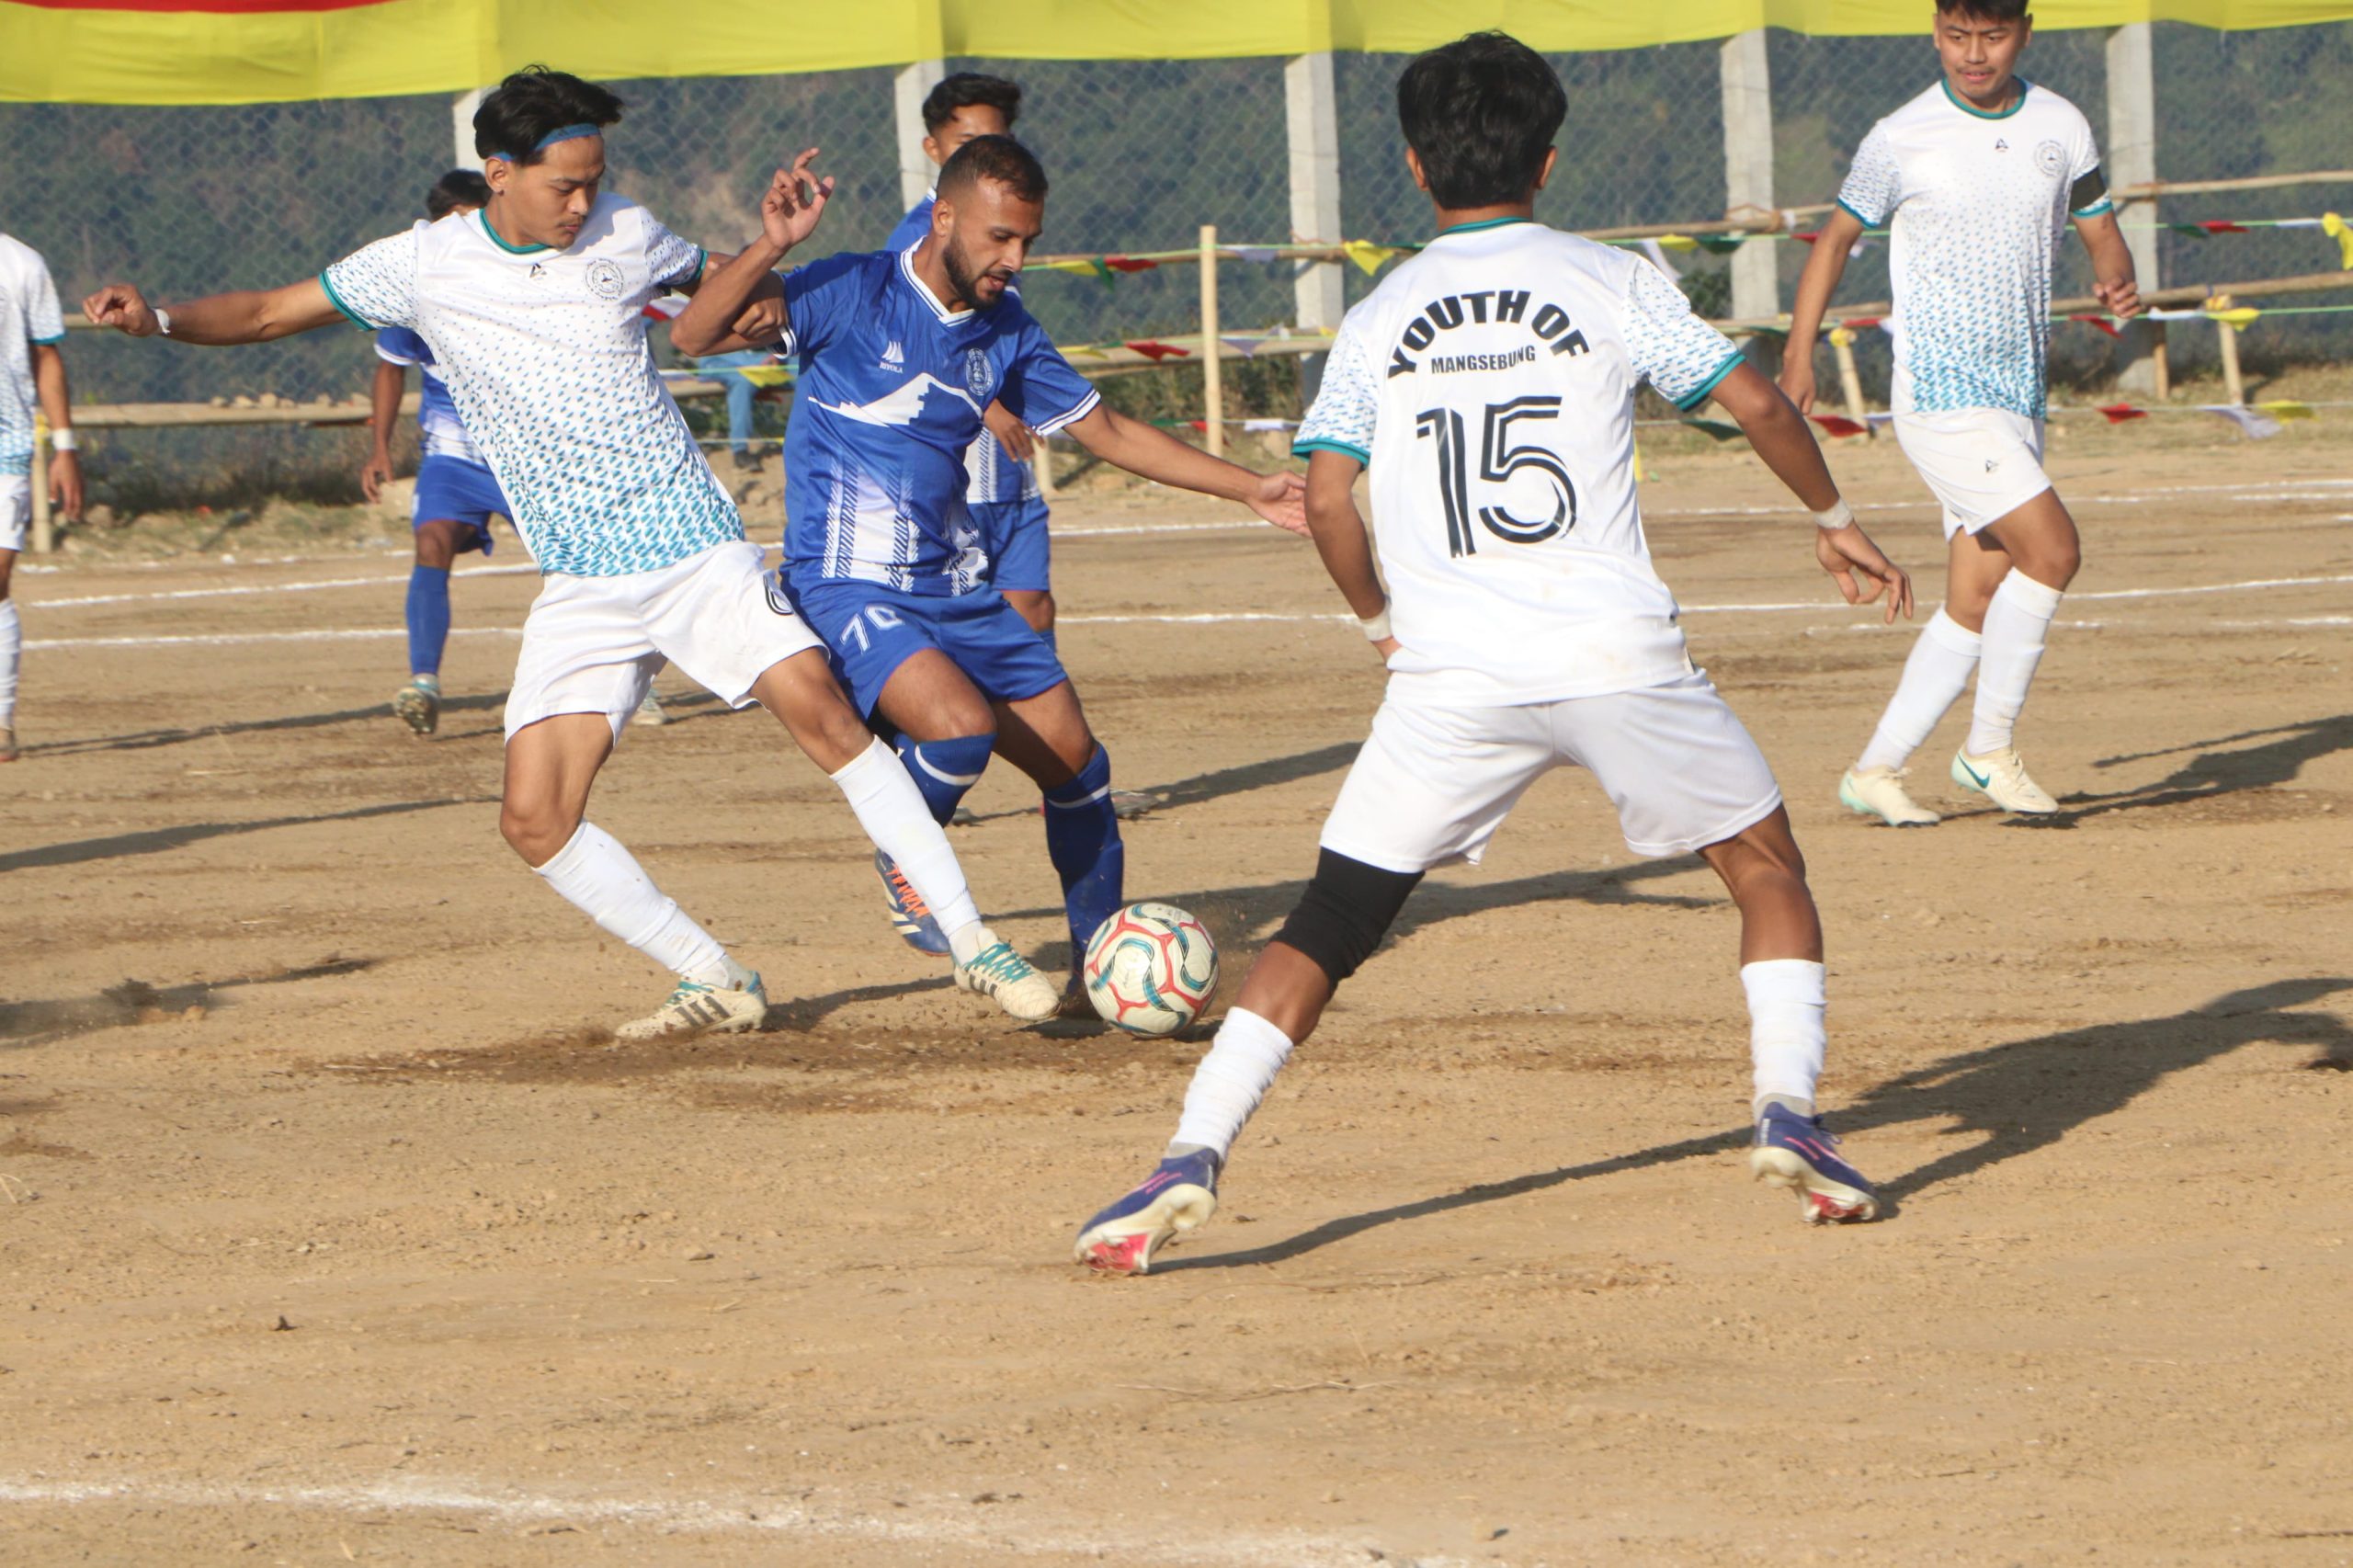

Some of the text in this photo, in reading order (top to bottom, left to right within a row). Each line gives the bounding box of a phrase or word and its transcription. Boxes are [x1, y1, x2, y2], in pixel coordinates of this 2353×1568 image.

[1387, 290, 1591, 379] YOUTH OF
[1430, 345, 1537, 375] MANGSEBUNG
[1415, 395, 1578, 559] 15
